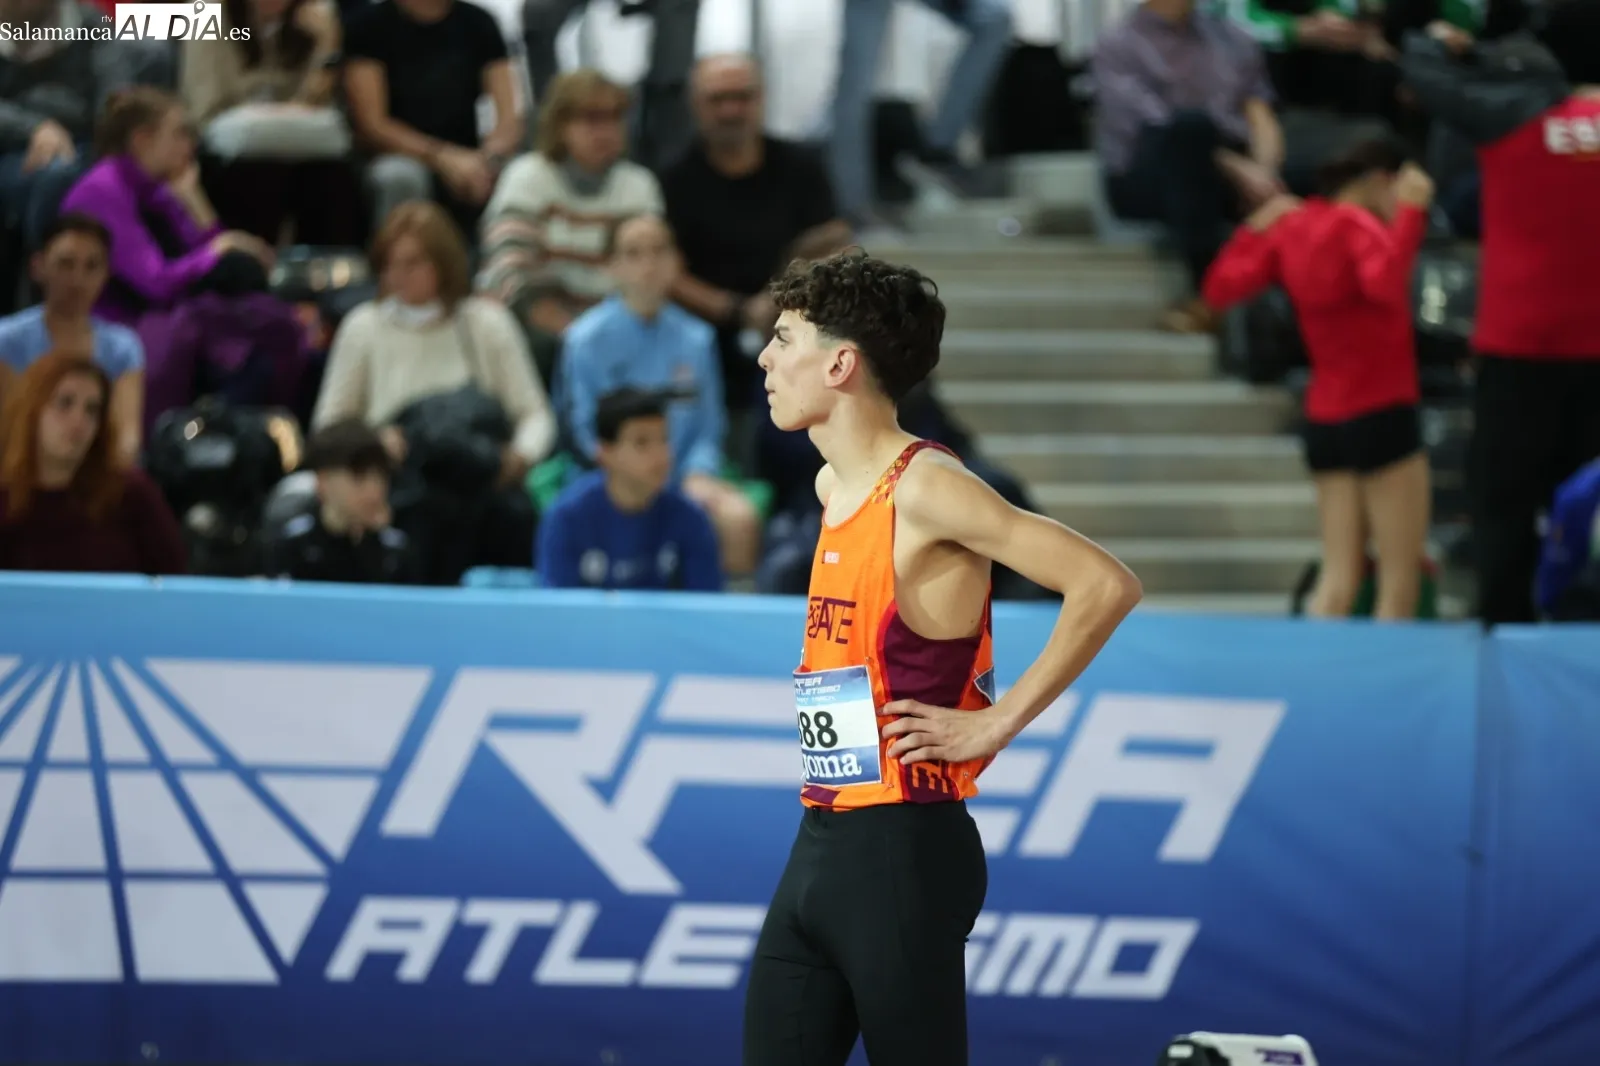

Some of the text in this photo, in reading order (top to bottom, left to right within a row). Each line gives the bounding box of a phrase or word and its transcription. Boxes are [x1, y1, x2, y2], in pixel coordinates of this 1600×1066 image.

[1542, 115, 1600, 155] ES
[797, 711, 839, 749] 88
[326, 895, 1198, 1000] ATLEMO
